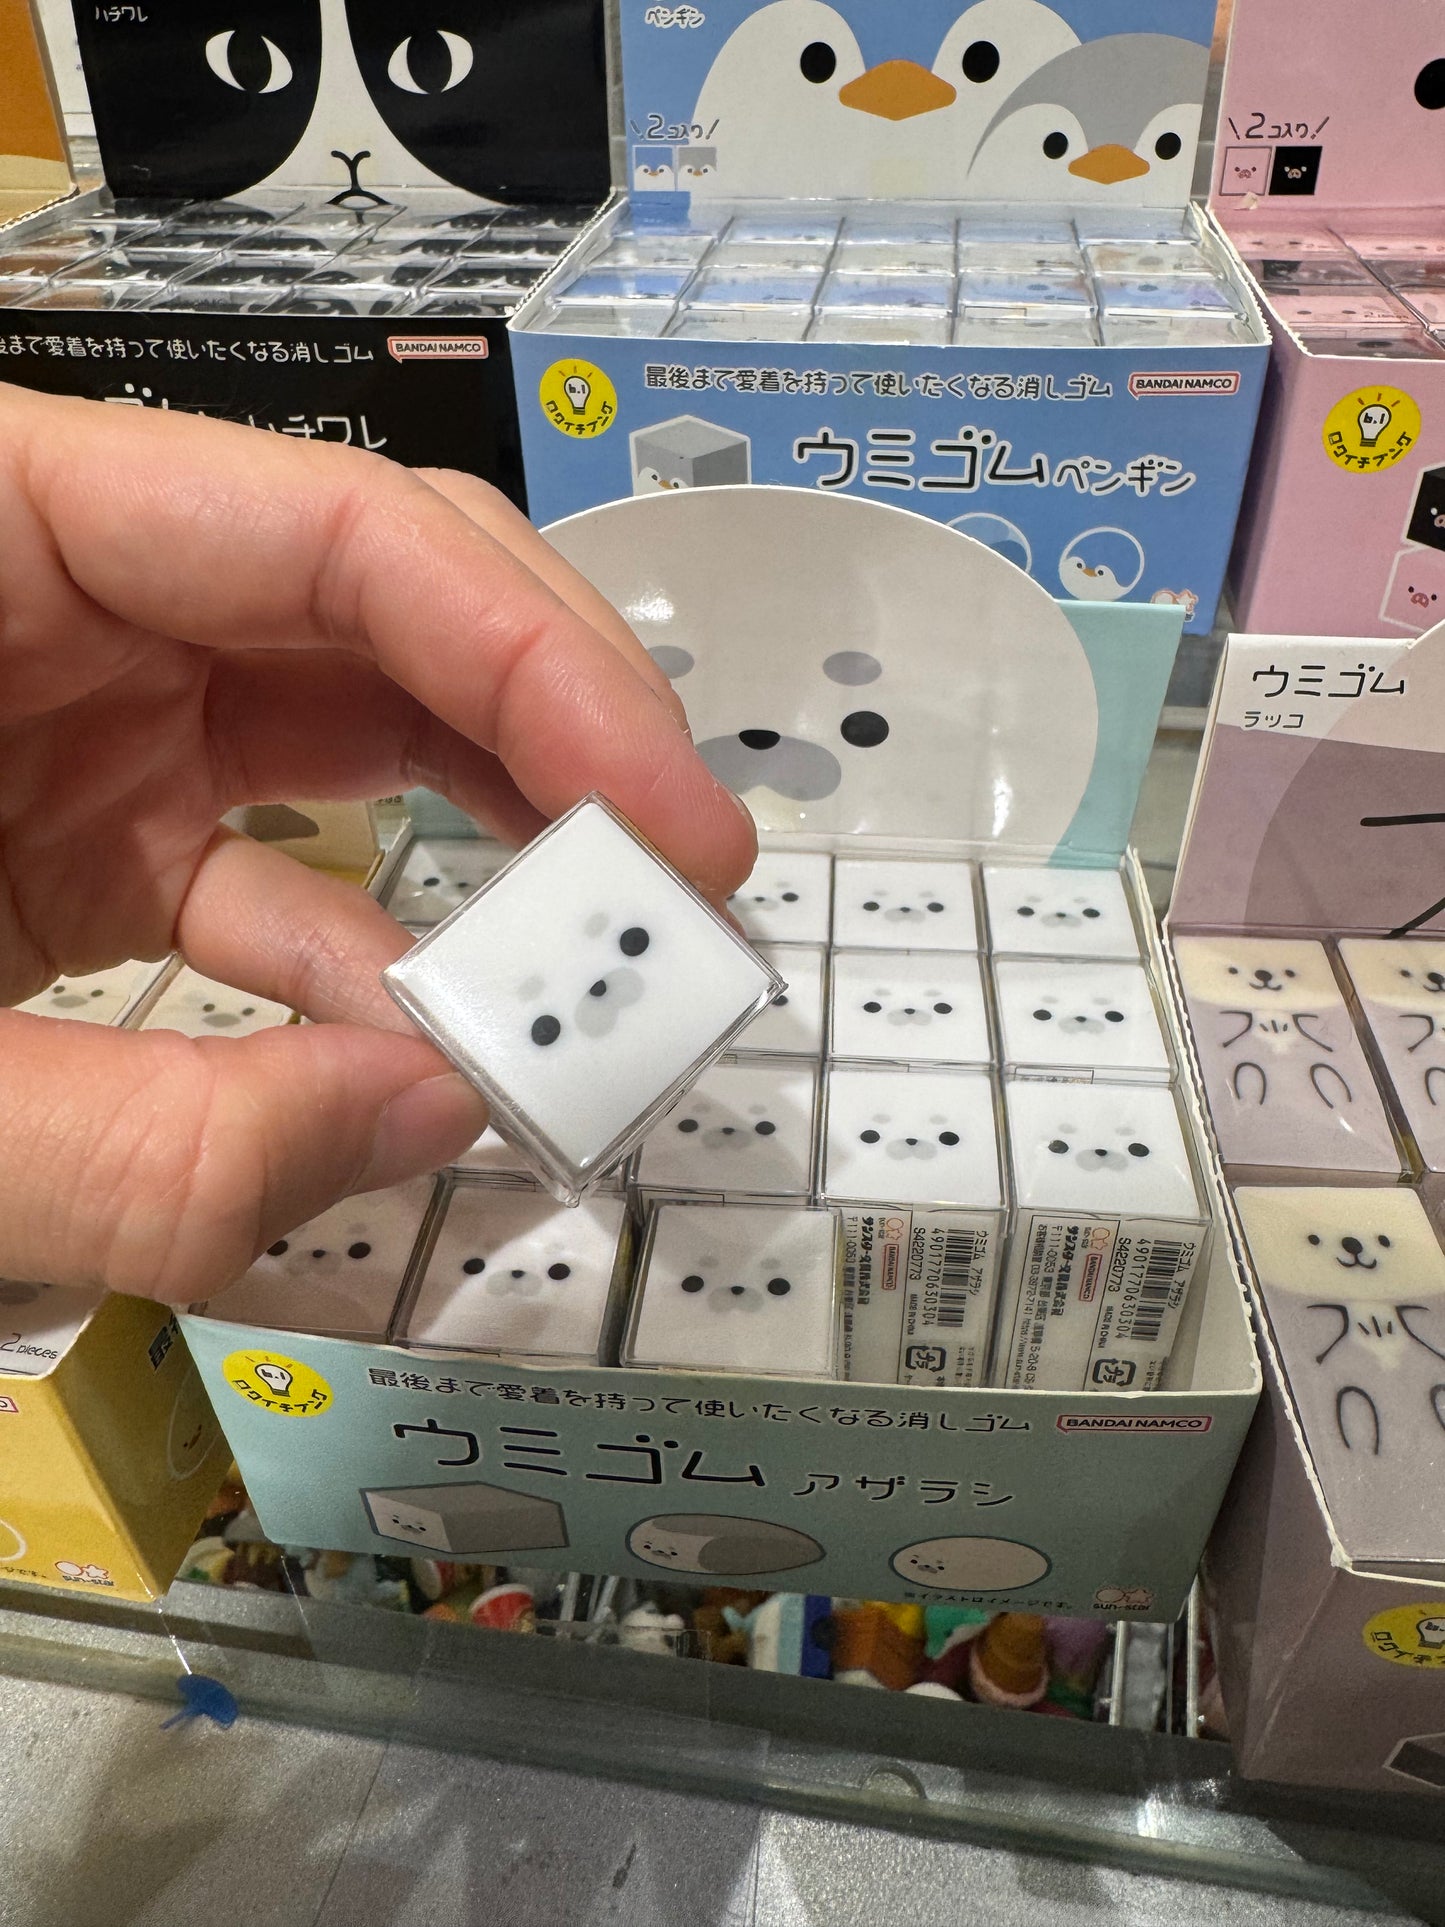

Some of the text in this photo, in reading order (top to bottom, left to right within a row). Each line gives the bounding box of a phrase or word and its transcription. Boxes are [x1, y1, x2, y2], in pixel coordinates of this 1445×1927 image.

[96, 6, 148, 22] ハチワレ
[648, 8, 702, 25] ペンギン
[395, 343, 481, 353] BANDAI NAMCO
[646, 365, 1112, 399] 最後まで愛着を持って使いたくなる消しゴム
[1136, 377, 1233, 389] BANDAI NAMCO
[797, 430, 1191, 493] ウミゴム ペンギン
[1252, 664, 1405, 698] ウミゴム
[1244, 711, 1304, 729] ラッコ
[909, 1227, 926, 1280] S4220773
[1107, 1236, 1131, 1292] S4220773
[921, 1227, 944, 1326] 4901770630304
[1115, 1238, 1148, 1338] 4901770630304
[368, 1367, 1030, 1432] 最後まで愛着を持って使いたくなる消しゴム
[1066, 1418, 1203, 1429] BANDAI NAMCO
[393, 1418, 1014, 1507] ウミゴム アザラシ
